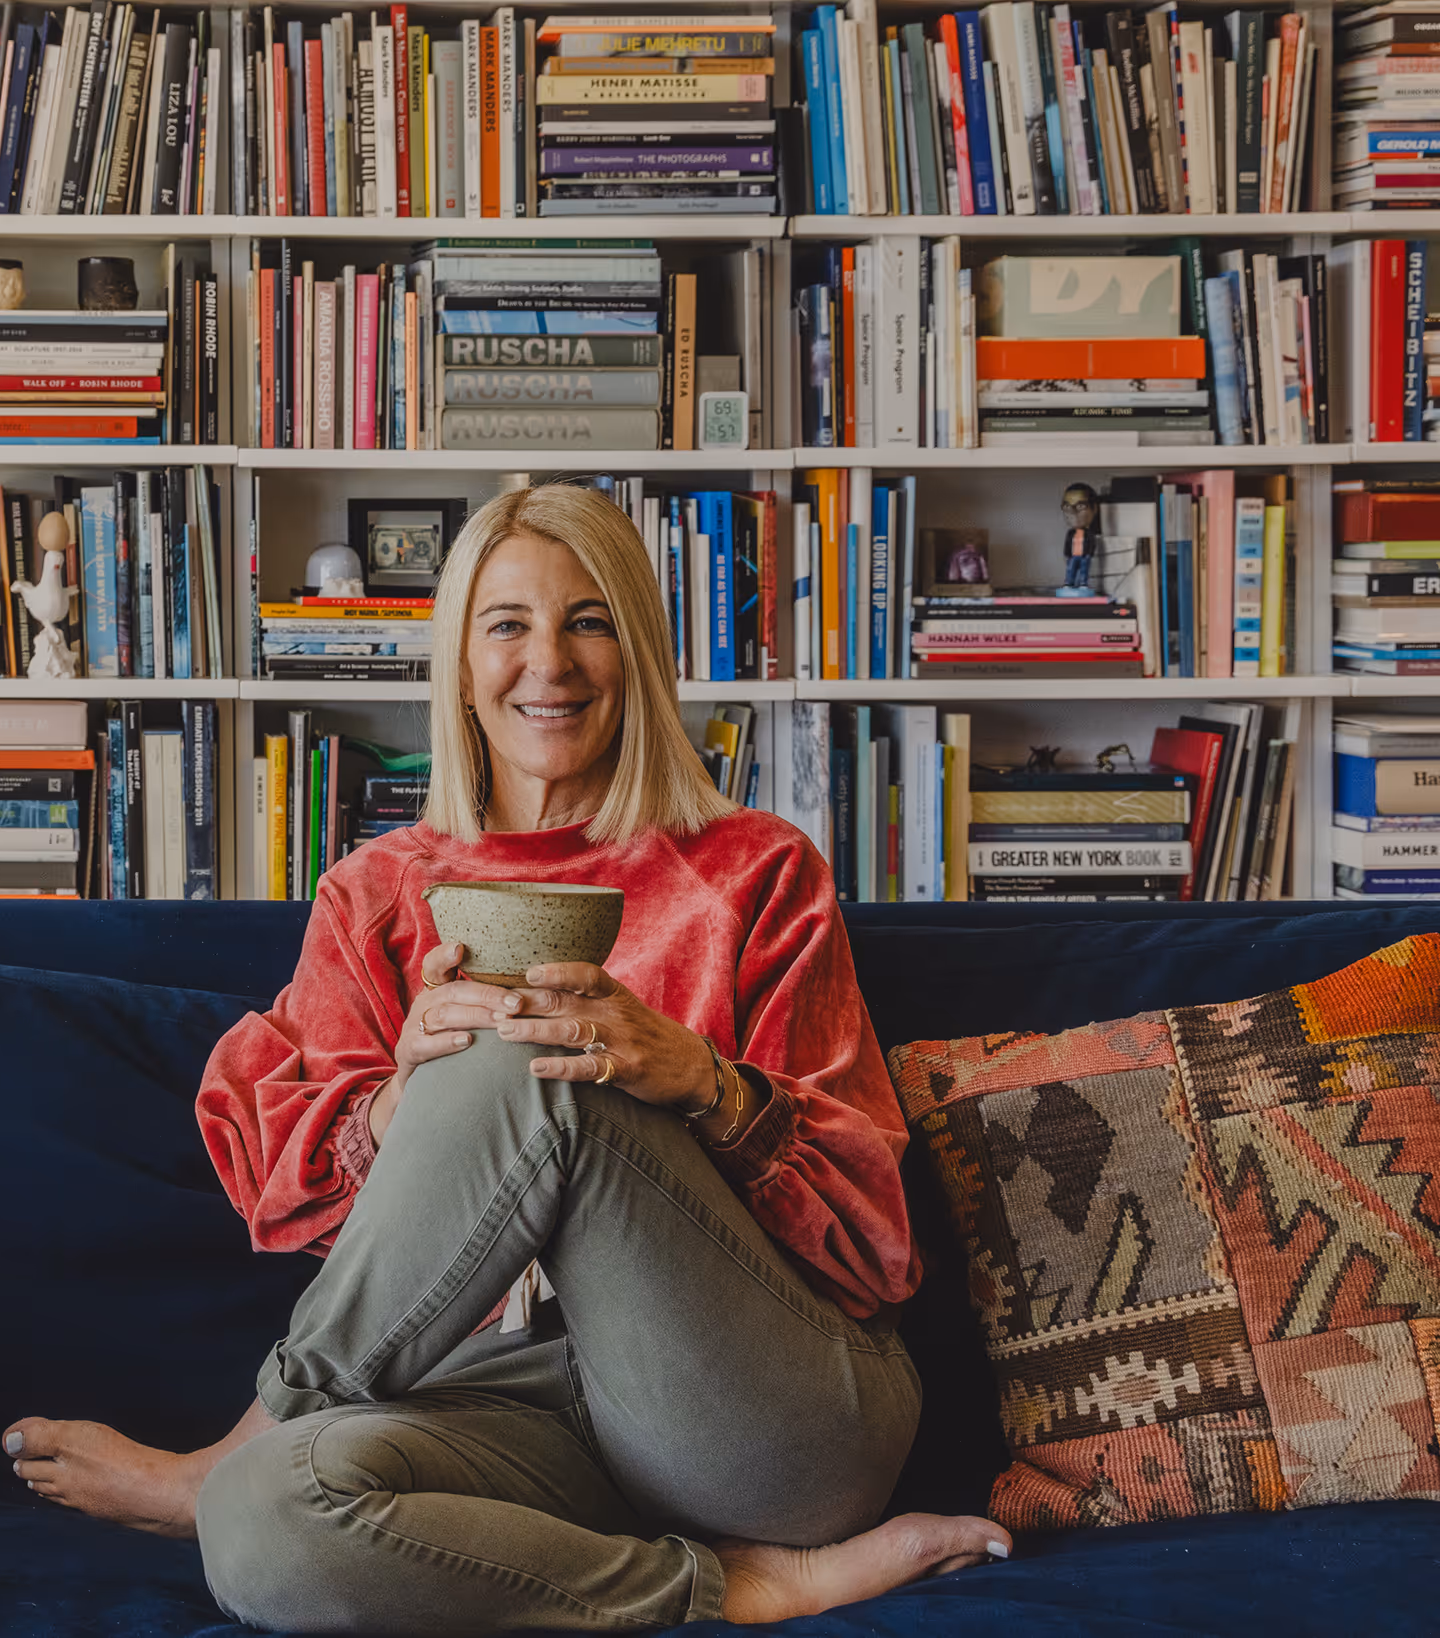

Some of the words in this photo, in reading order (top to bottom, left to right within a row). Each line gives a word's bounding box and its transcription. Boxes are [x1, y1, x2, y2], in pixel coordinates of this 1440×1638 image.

[89, 12, 103, 35] ROY
[502, 15, 512, 49] MARK
[381, 35, 390, 58] Mark
[411, 33, 422, 62] Mark
[467, 25, 477, 58] MARK
[485, 30, 496, 67] MARK
[595, 36, 641, 52] JULIE
[645, 36, 726, 52] MEHRETU
[78, 36, 99, 108] LICHTENSTEIN
[381, 59, 390, 98] Manders
[411, 64, 422, 112] Manders
[502, 54, 512, 113] MANDERS
[591, 79, 634, 88] HENRI
[640, 78, 699, 88] MATISSE
[167, 82, 181, 114] LIZA
[467, 62, 477, 118] MANDERS
[485, 71, 496, 133] MANDERS
[165, 118, 178, 147] LOU
[1376, 140, 1429, 151] GEROLD
[638, 154, 656, 164] THE
[658, 154, 727, 164] PHOTOGRAPHS
[206, 281, 217, 317] ROBIN
[205, 318, 216, 359] RHODE
[319, 291, 332, 357] AMANDA
[680, 327, 690, 342] ED
[860, 313, 871, 342] Space
[894, 313, 906, 345] Space
[1404, 251, 1423, 407] SCHEIBITZ
[451, 337, 595, 365] RUSCHA
[859, 344, 871, 385] Program
[22, 379, 47, 388] WALK
[48, 379, 66, 388] OFF
[79, 379, 108, 388] ROBIN
[110, 379, 143, 388] RHODE
[679, 348, 690, 398] RUSCHA
[893, 348, 905, 394] Program
[318, 360, 332, 430] ROSS-HO
[452, 374, 594, 401] RUSCHA
[451, 414, 592, 440] RUSCHA
[872, 535, 887, 589] LOOKING
[717, 591, 726, 604] THE
[872, 592, 887, 609] UP
[927, 635, 980, 643] HANNAH
[983, 635, 1018, 643] WILKE
[193, 705, 203, 742] EMIRATI
[193, 742, 203, 807] EXPRESSIONS
[835, 774, 848, 801] Getty
[193, 807, 203, 826] 2011
[991, 850, 1049, 868] GREATER
[1052, 850, 1082, 867] NEW
[1086, 850, 1122, 867] YORK
[1125, 850, 1162, 866] BOOK
[1381, 845, 1439, 857] HAMMER
